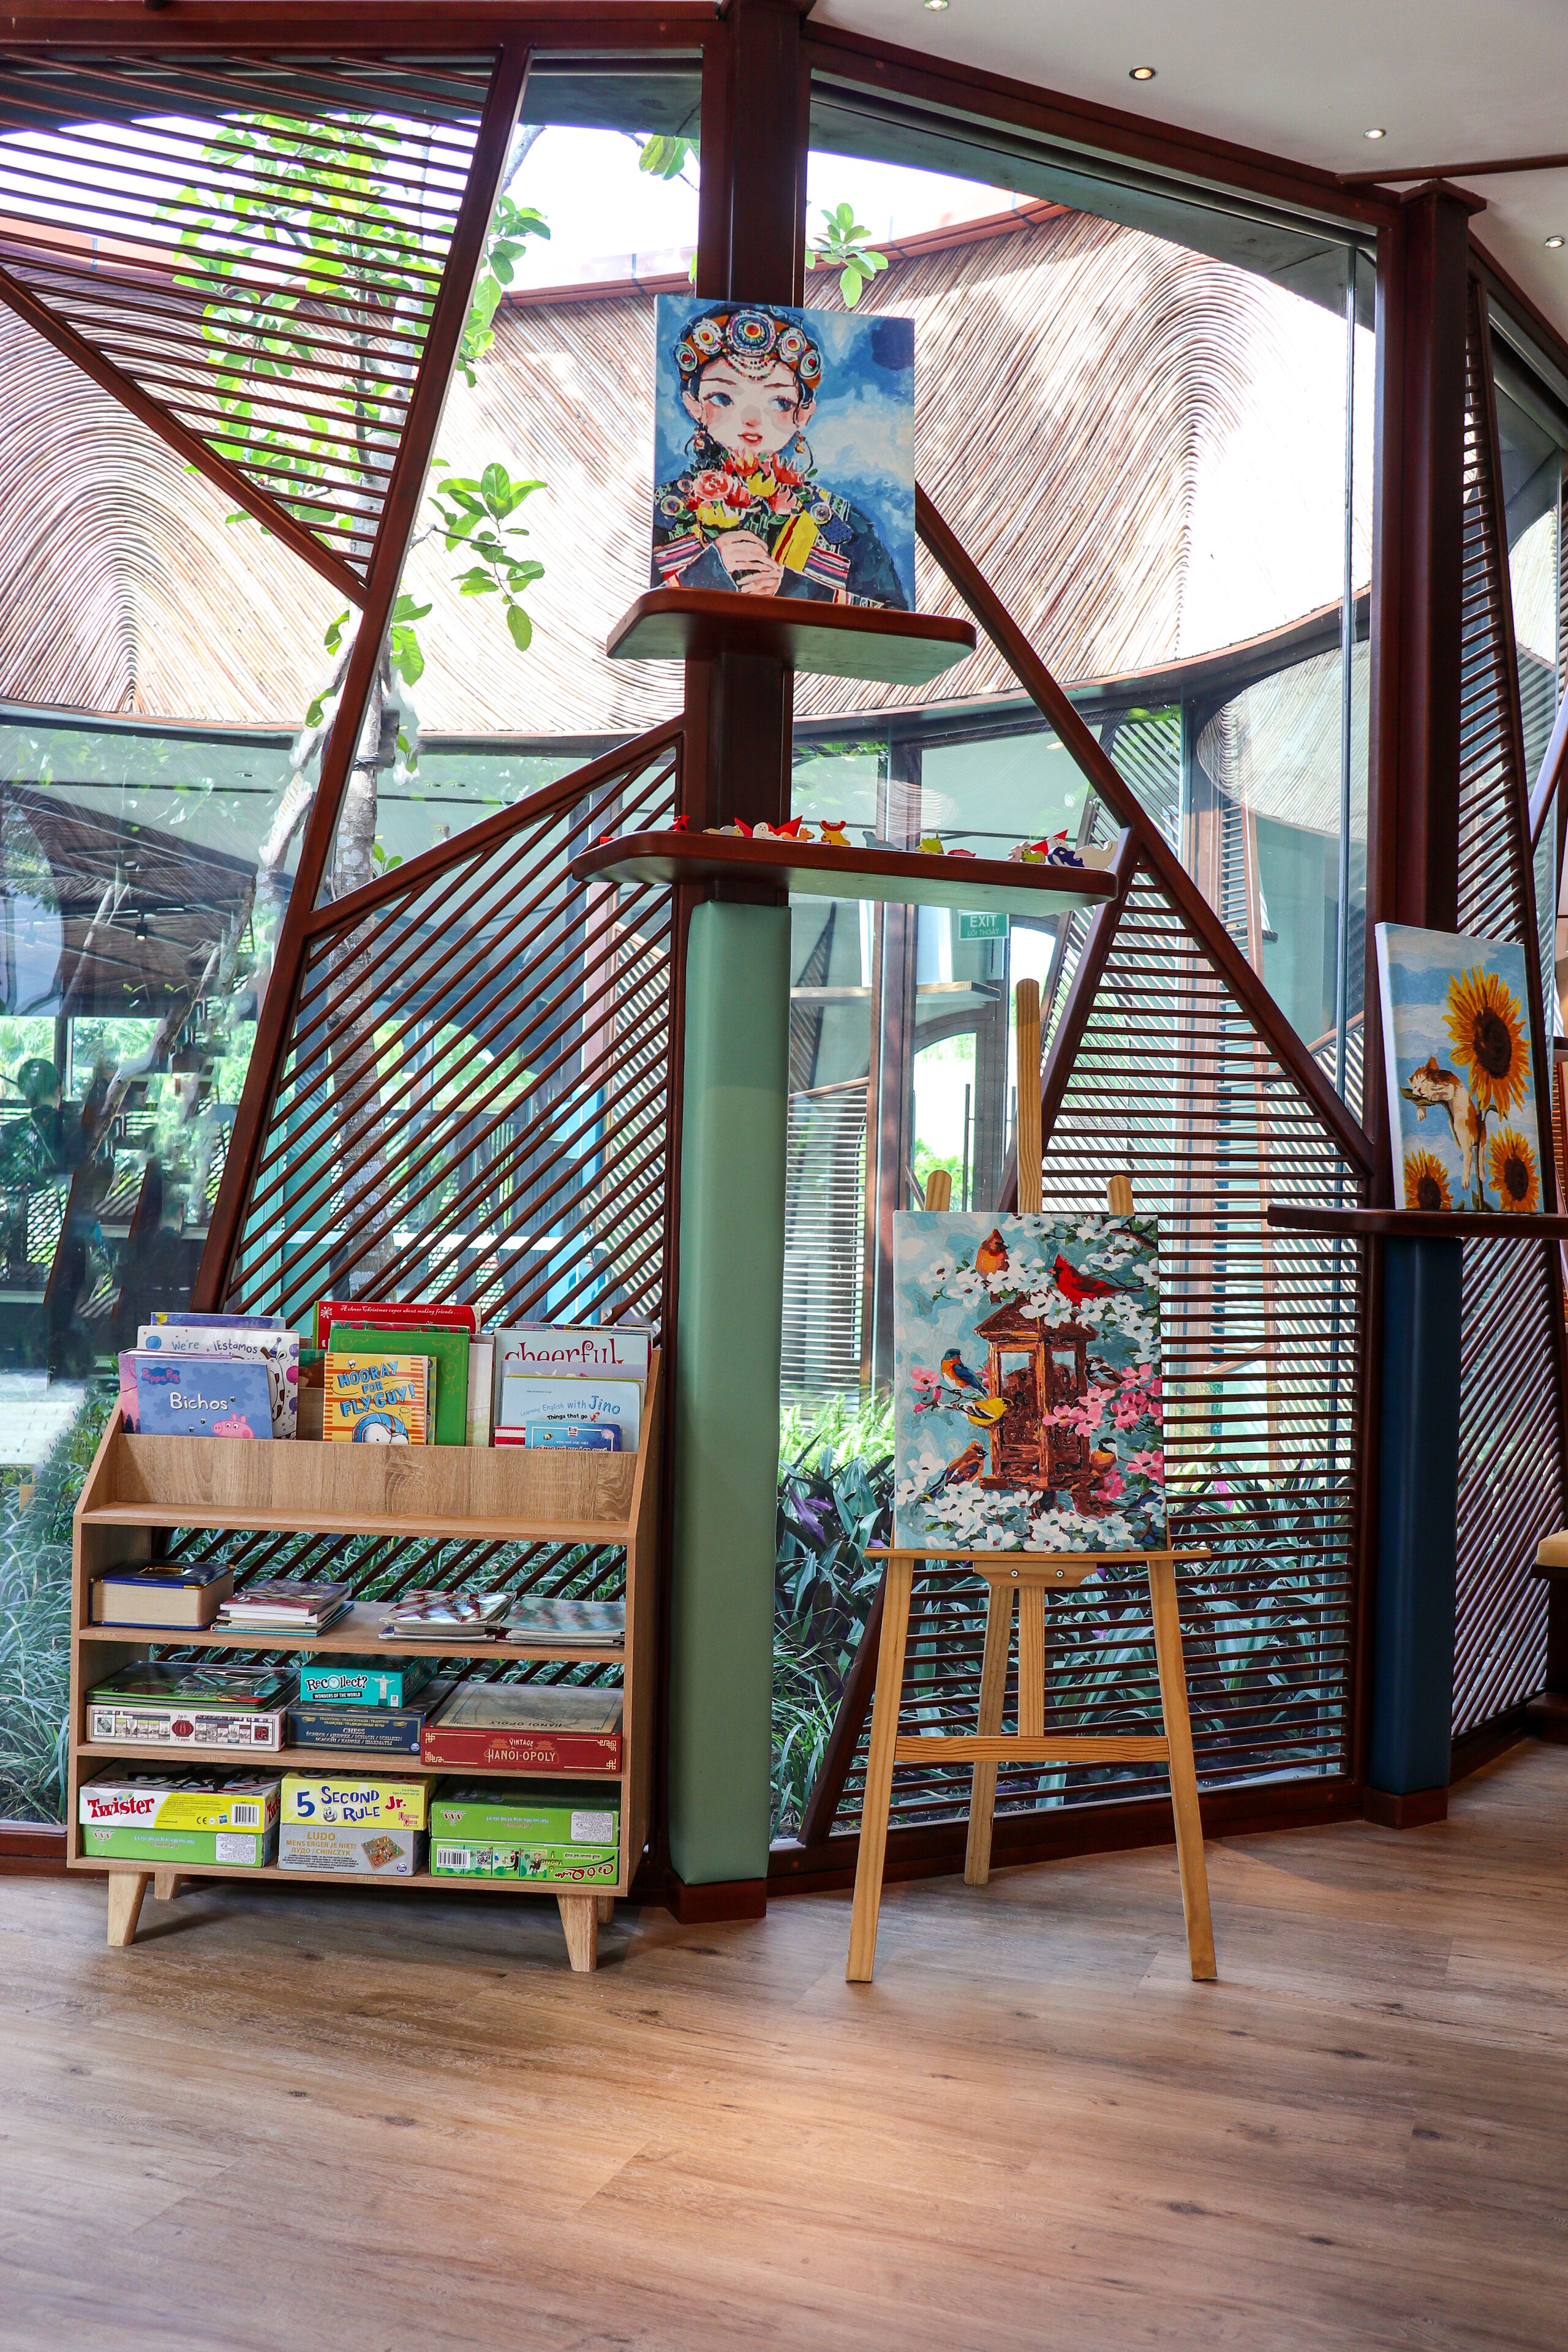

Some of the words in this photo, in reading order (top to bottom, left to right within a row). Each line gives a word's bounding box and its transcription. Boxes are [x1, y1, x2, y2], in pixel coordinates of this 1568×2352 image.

[970, 915, 997, 927] EXIT
[172, 1340, 199, 1351] We're
[141, 1367, 166, 1382] Peppa
[166, 1368, 179, 1382] Pig
[337, 1360, 398, 1388] HOORAY
[362, 1381, 383, 1394] FOR
[170, 1392, 228, 1411] Bichos
[340, 1395, 371, 1417] FLY
[374, 1384, 416, 1408] GUY!
[520, 1408, 540, 1417] Learning
[543, 1403, 564, 1412] English
[567, 1399, 586, 1409] with
[588, 1395, 620, 1415] Jino
[509, 1738, 534, 1747] VINTAGE
[487, 1749, 557, 1763] HANOI-OPOLY
[321, 1785, 380, 1804] SECOND
[87, 1796, 154, 1818] Twister
[297, 1791, 315, 1817] 5
[385, 1796, 407, 1811] Jr.
[343, 1806, 380, 1822] RULE
[307, 1832, 336, 1841] LUDO
[554, 1868, 585, 1881] Quan
[587, 1867, 596, 1879] Ô
